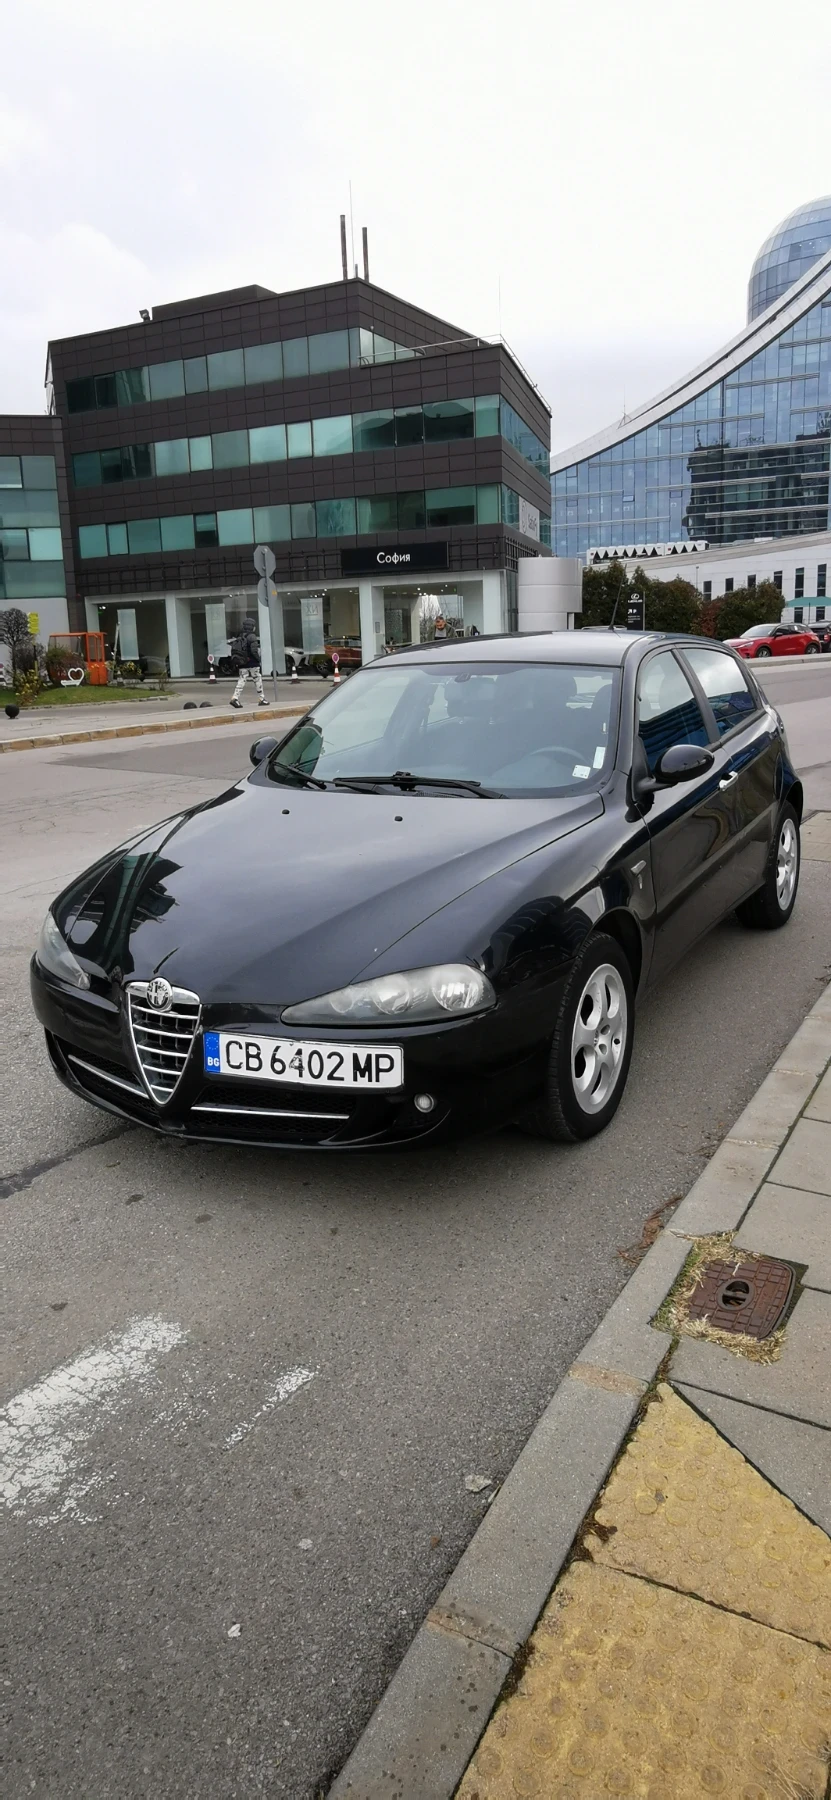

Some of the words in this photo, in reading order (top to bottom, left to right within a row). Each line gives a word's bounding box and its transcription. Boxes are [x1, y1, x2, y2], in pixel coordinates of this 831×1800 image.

[377, 552, 410, 564] София
[207, 1057, 219, 1066] BG
[226, 1040, 262, 1071] CB
[270, 1046, 344, 1081] 6402
[353, 1053, 394, 1082] MP
